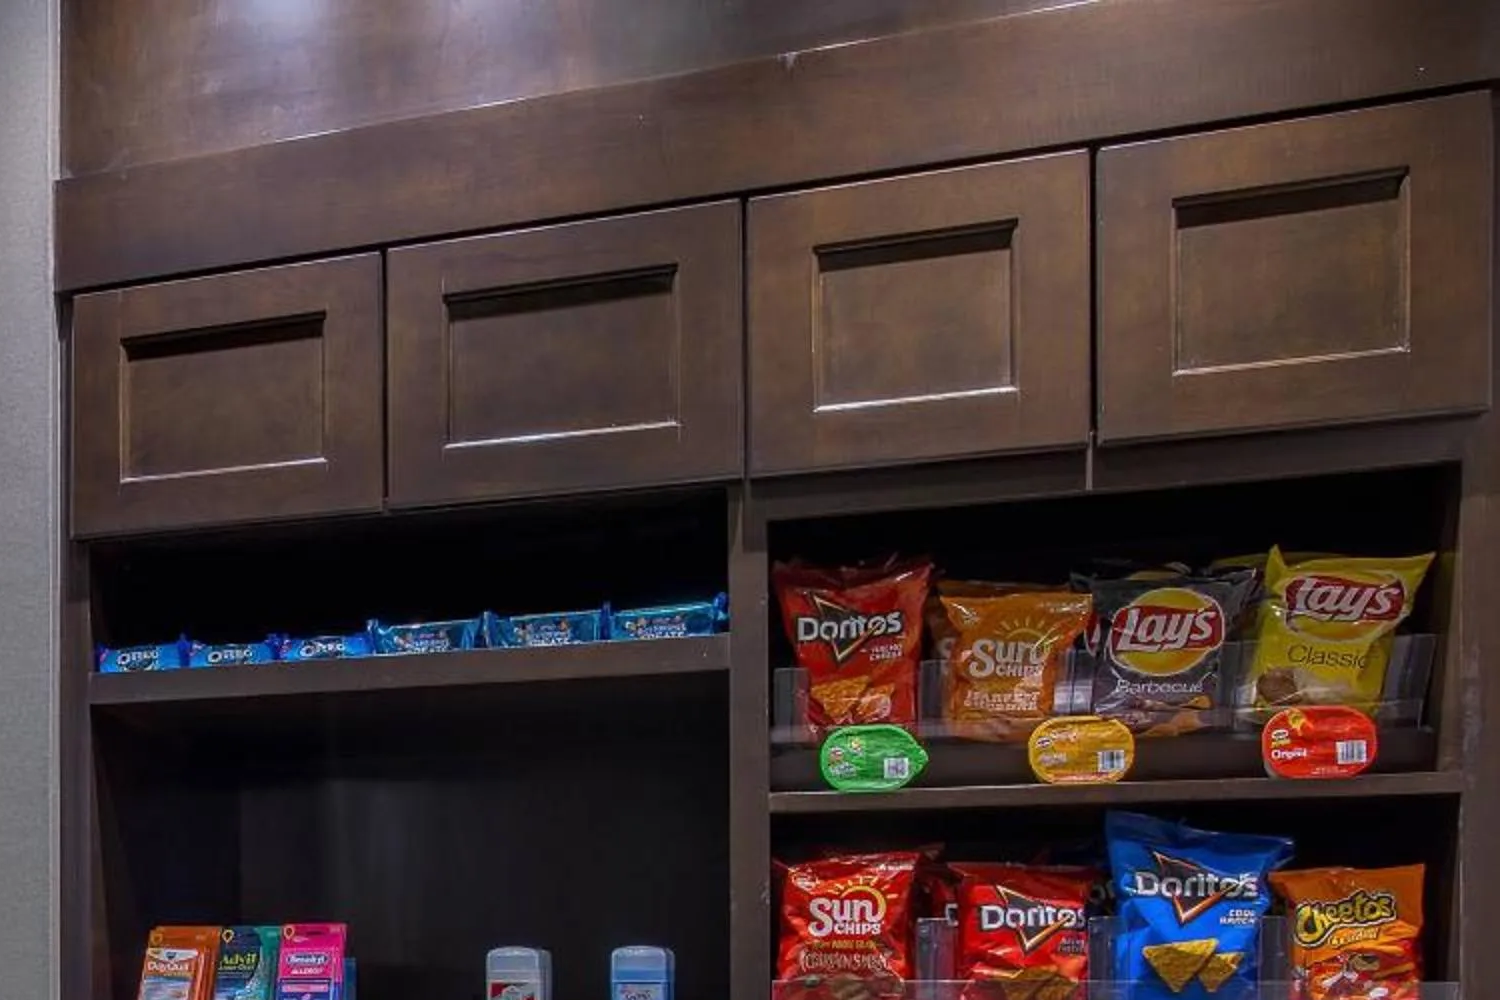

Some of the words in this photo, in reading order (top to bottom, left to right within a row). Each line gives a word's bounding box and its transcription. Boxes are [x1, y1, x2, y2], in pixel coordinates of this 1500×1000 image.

[797, 611, 902, 641] Doritos
[1115, 607, 1217, 653] Lay's
[1287, 644, 1368, 669] Classic
[1116, 678, 1204, 694] Barbecue
[1136, 870, 1259, 899] Doritos
[808, 896, 884, 938] Sun
[833, 921, 882, 936] CHIPS
[980, 904, 1085, 930] Doritos
[1296, 890, 1395, 945] Cheetos
[222, 953, 258, 966] Advil
